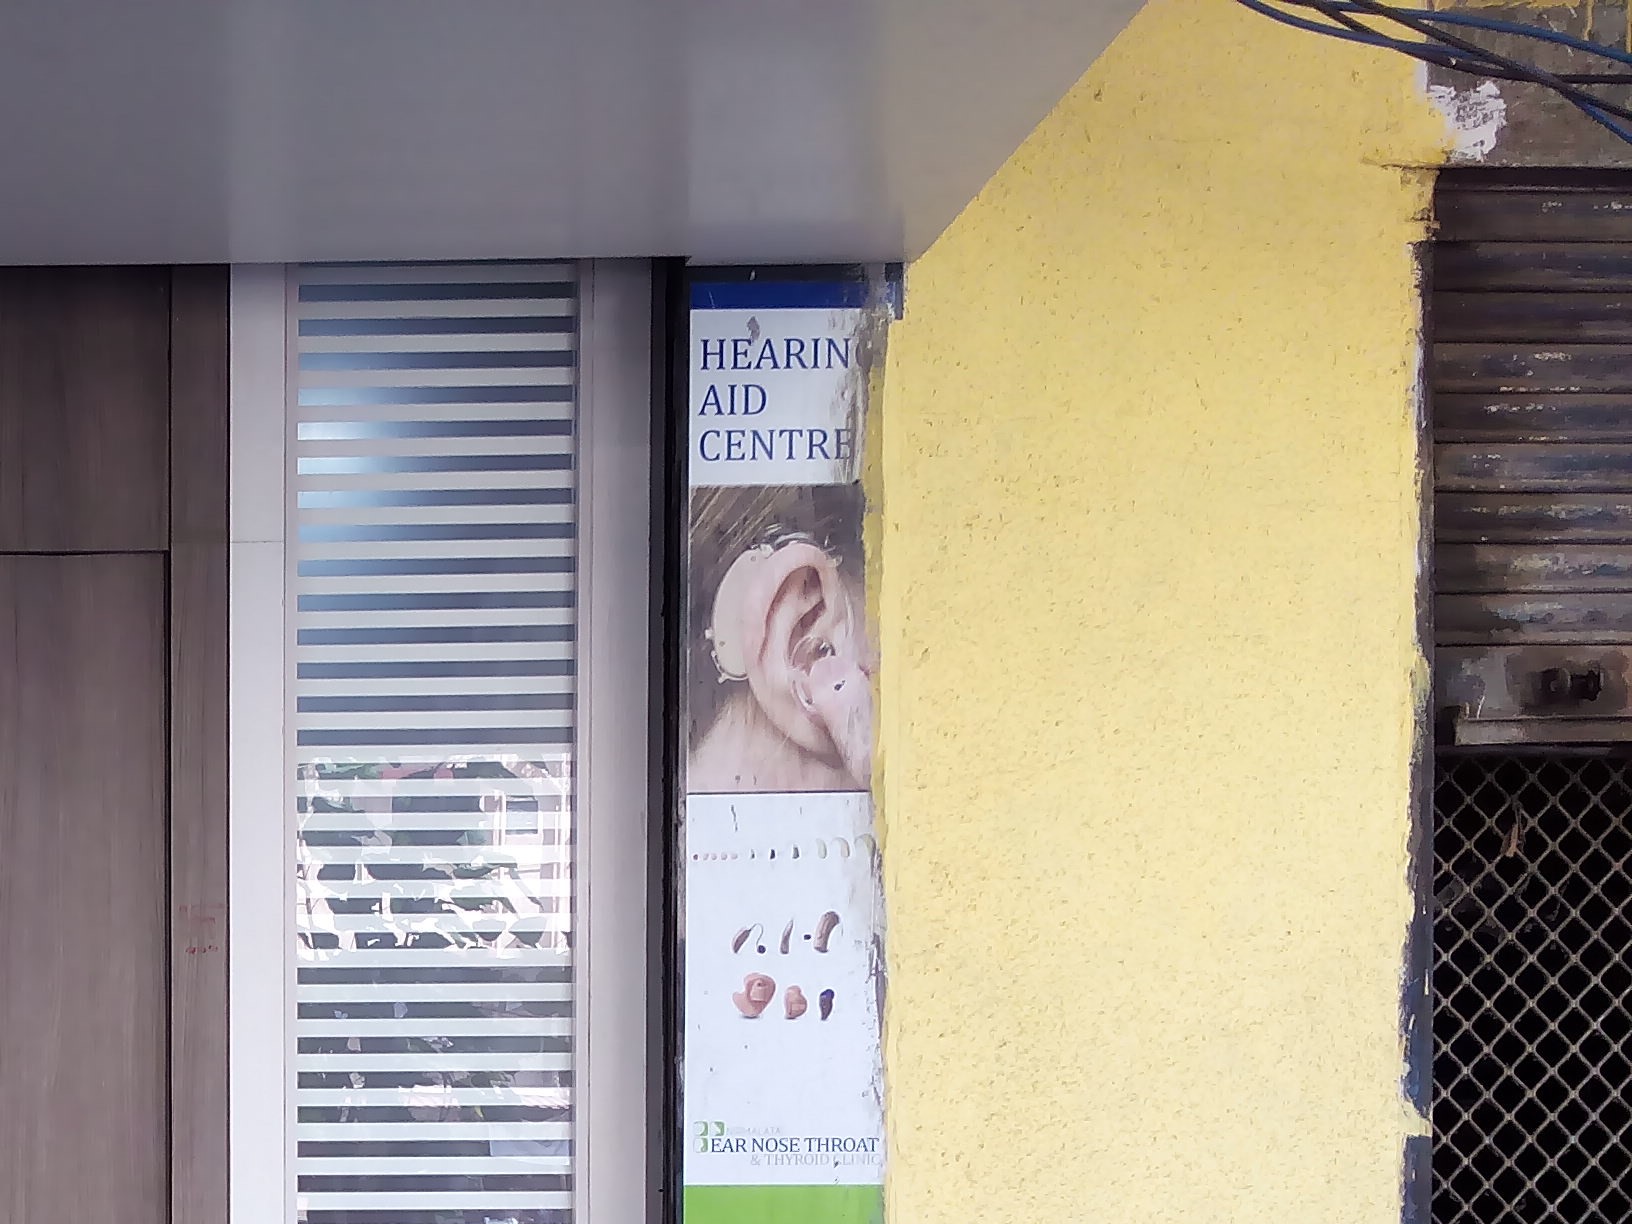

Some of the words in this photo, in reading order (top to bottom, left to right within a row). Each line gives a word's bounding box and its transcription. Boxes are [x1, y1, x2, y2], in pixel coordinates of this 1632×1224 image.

[701, 338, 851, 370] HEARIN
[698, 384, 766, 416] AID
[699, 429, 852, 461] CENTRE
[711, 1138, 747, 1152] EAR
[752, 1138, 800, 1152] NOSE
[804, 1137, 879, 1152] THROAT
[751, 1154, 760, 1166] &
[766, 1154, 829, 1166] THYROID
